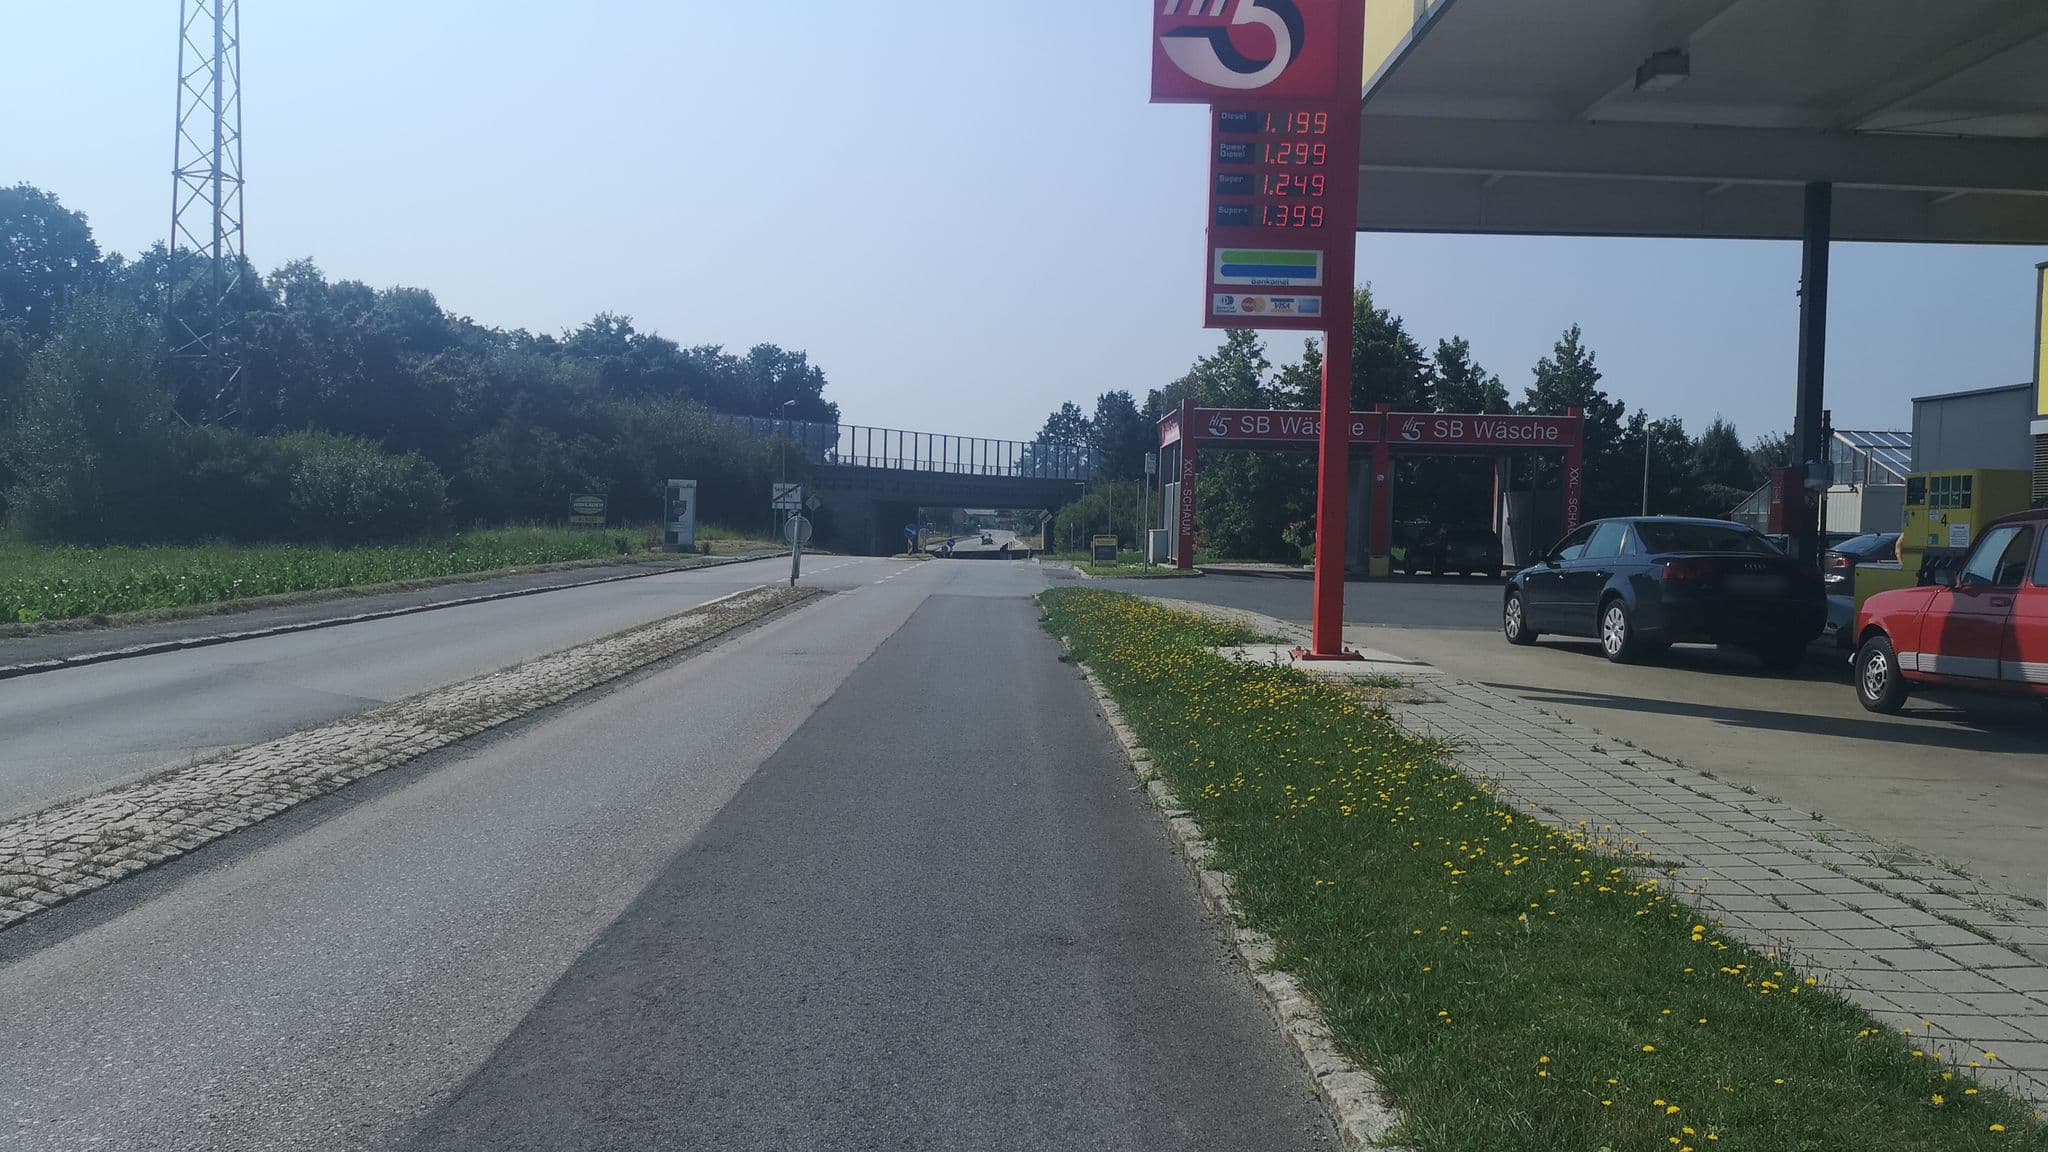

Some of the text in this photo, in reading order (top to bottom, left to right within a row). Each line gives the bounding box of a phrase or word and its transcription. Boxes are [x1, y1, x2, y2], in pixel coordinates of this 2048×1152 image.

[1221, 112, 1327, 134] Diesel 1.199
[1265, 143, 1326, 165] 1.299
[1263, 174, 1325, 196] 1.249
[1262, 205, 1324, 227] 1.399
[1240, 415, 1270, 434] SB
[1433, 419, 1464, 438] SB
[1474, 421, 1559, 440] Wäsche
[1183, 458, 1193, 480] XXL
[1569, 466, 1579, 489] XXL
[1182, 489, 1192, 536] SCHAUM
[1941, 513, 1948, 527] 4
